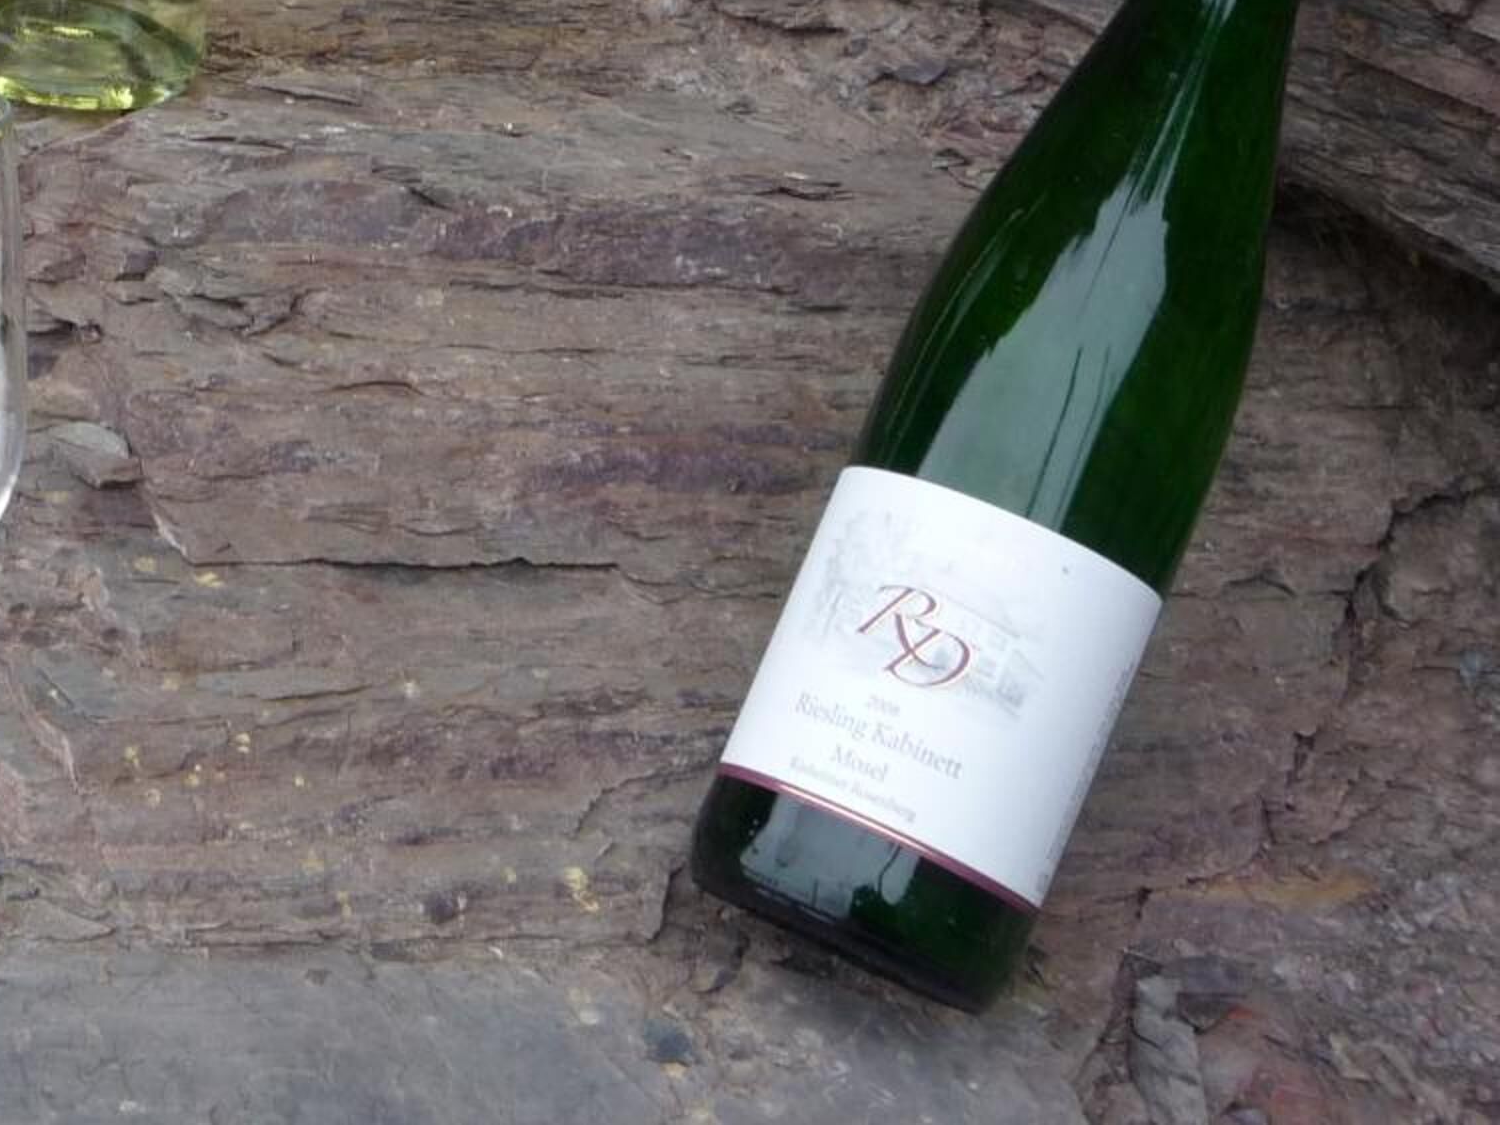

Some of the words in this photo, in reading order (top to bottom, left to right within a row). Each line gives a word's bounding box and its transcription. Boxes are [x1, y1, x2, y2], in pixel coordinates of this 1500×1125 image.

[857, 584, 973, 687] RD
[795, 691, 868, 740] Riesling
[871, 722, 963, 779] Kabinett
[830, 744, 889, 781] Mosel
